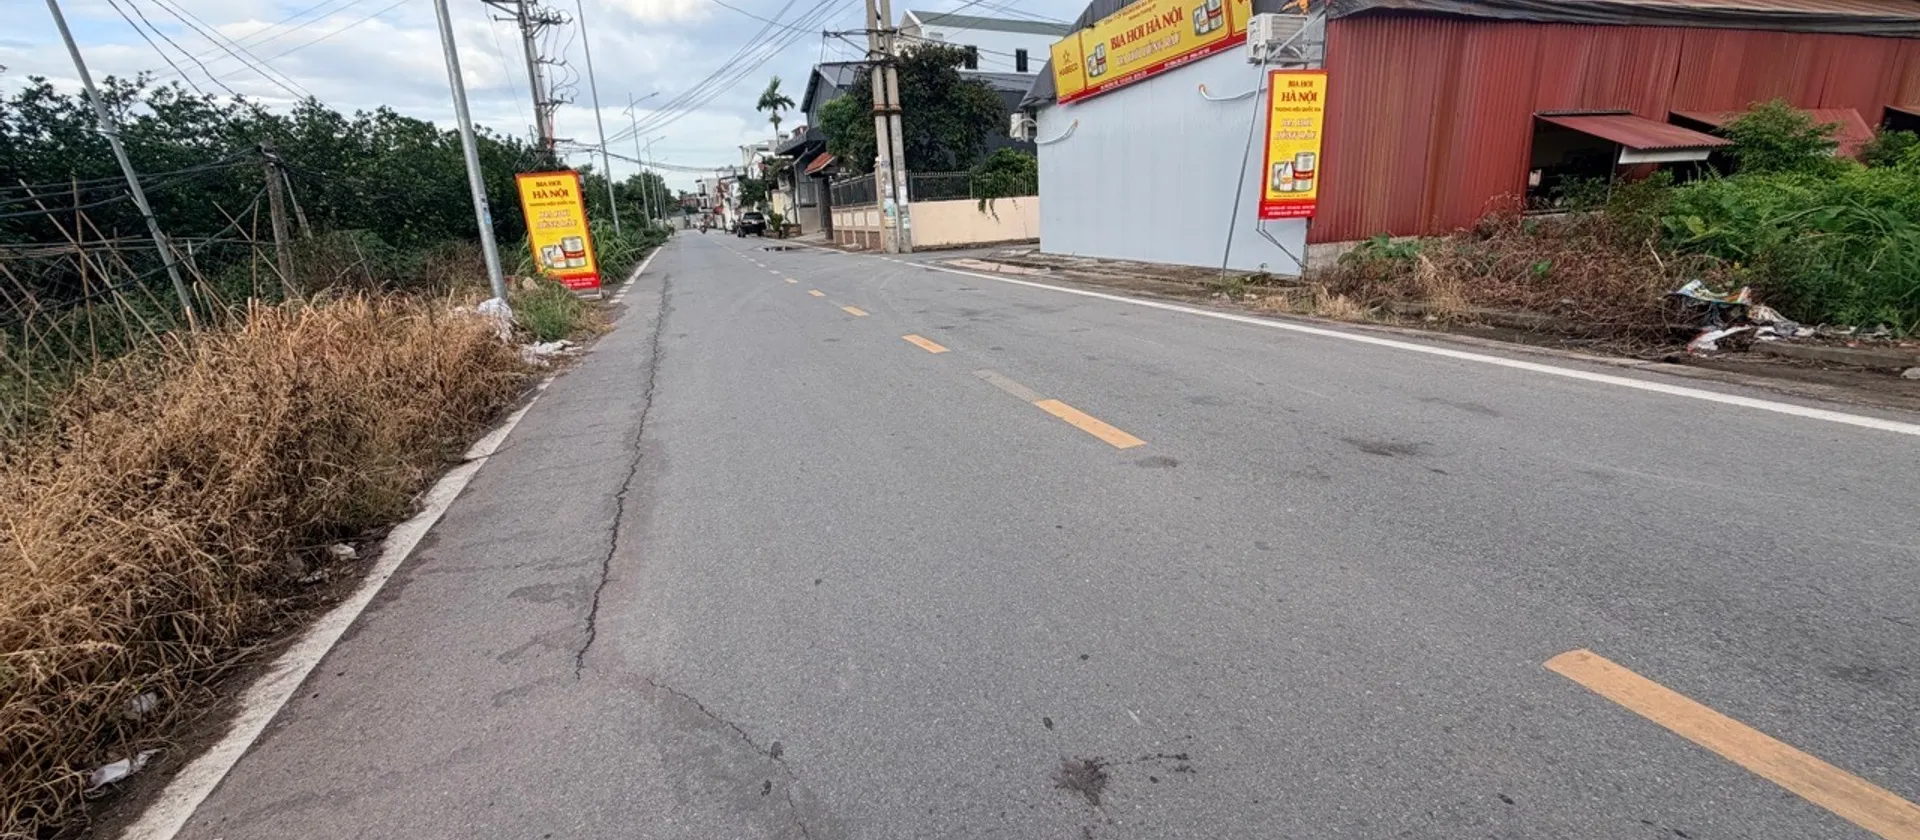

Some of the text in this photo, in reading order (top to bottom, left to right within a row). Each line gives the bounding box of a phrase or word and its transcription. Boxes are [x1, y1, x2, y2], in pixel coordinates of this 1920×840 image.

[1110, 35, 1126, 50] BIA
[1127, 25, 1145, 44] HƠI
[1145, 15, 1162, 36] HÀ
[1162, 6, 1184, 28] NỘI
[1281, 89, 1318, 104] HÀ NỘI
[532, 188, 569, 199] HÀ NỘI
